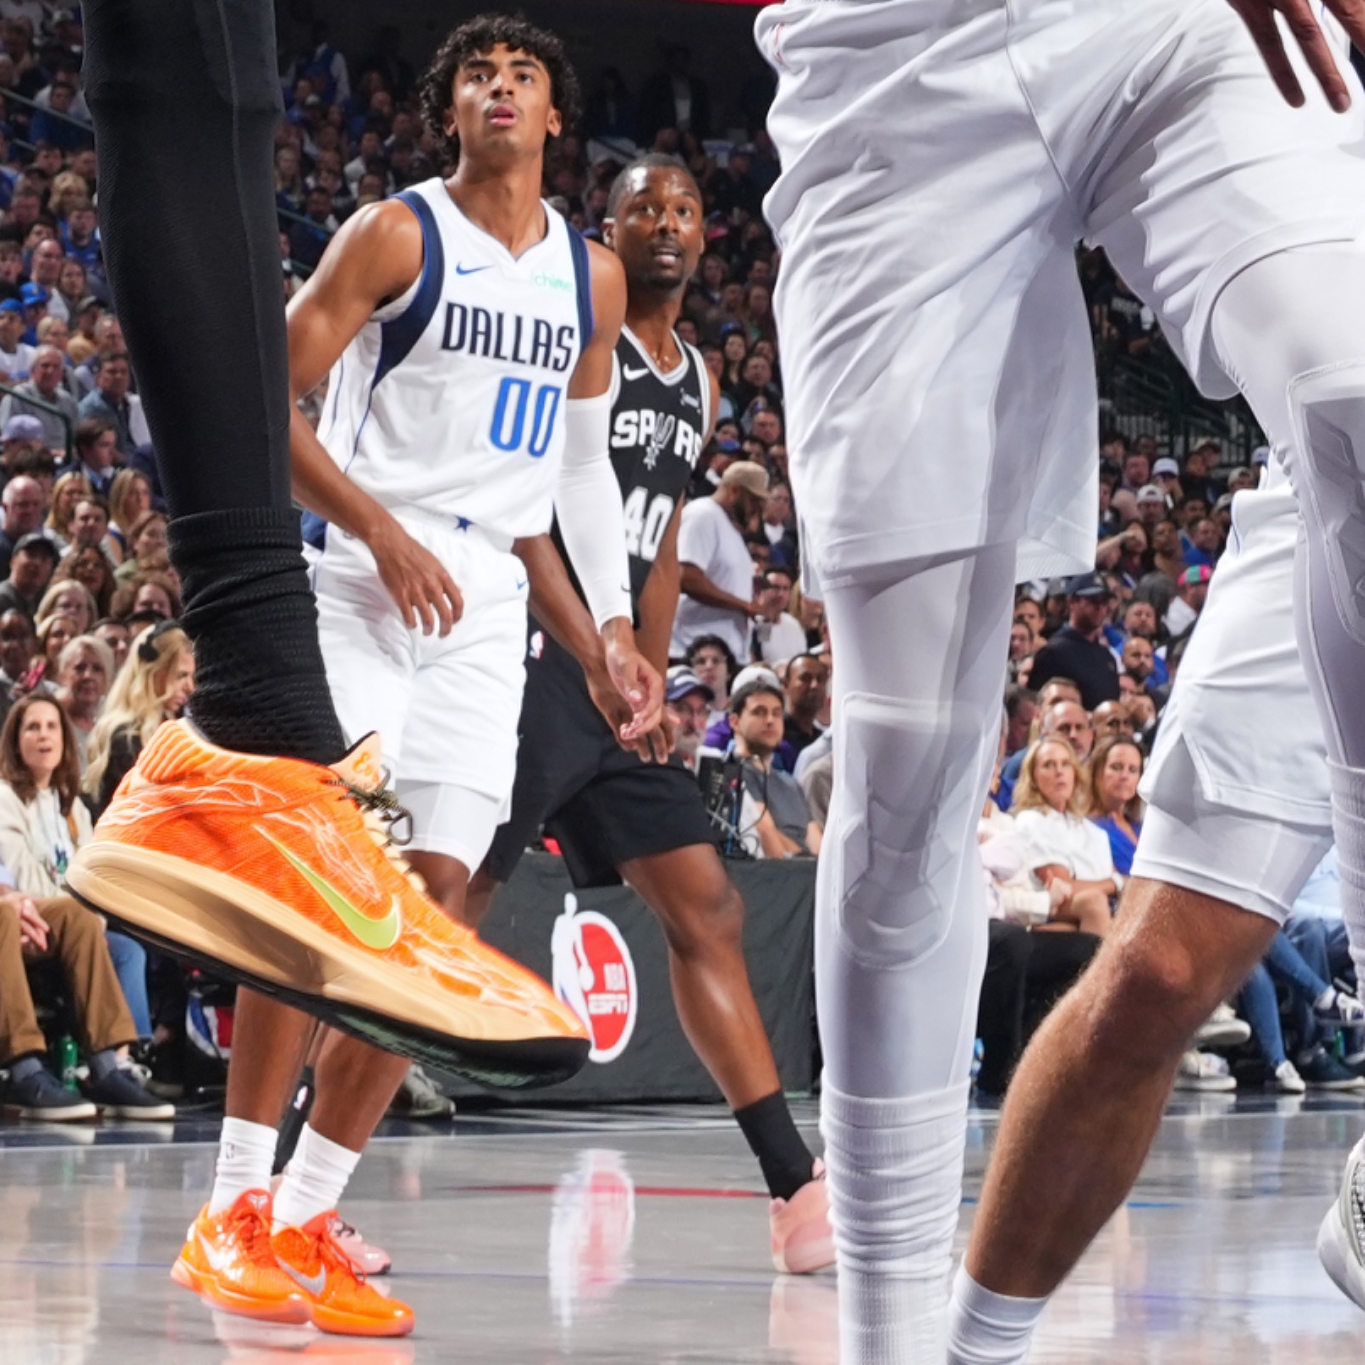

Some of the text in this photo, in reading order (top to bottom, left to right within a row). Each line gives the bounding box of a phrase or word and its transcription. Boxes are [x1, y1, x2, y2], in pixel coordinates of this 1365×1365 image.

[440, 300, 576, 373] DALLAS
[489, 375, 563, 459] 00
[587, 992, 629, 1016] ESPN
